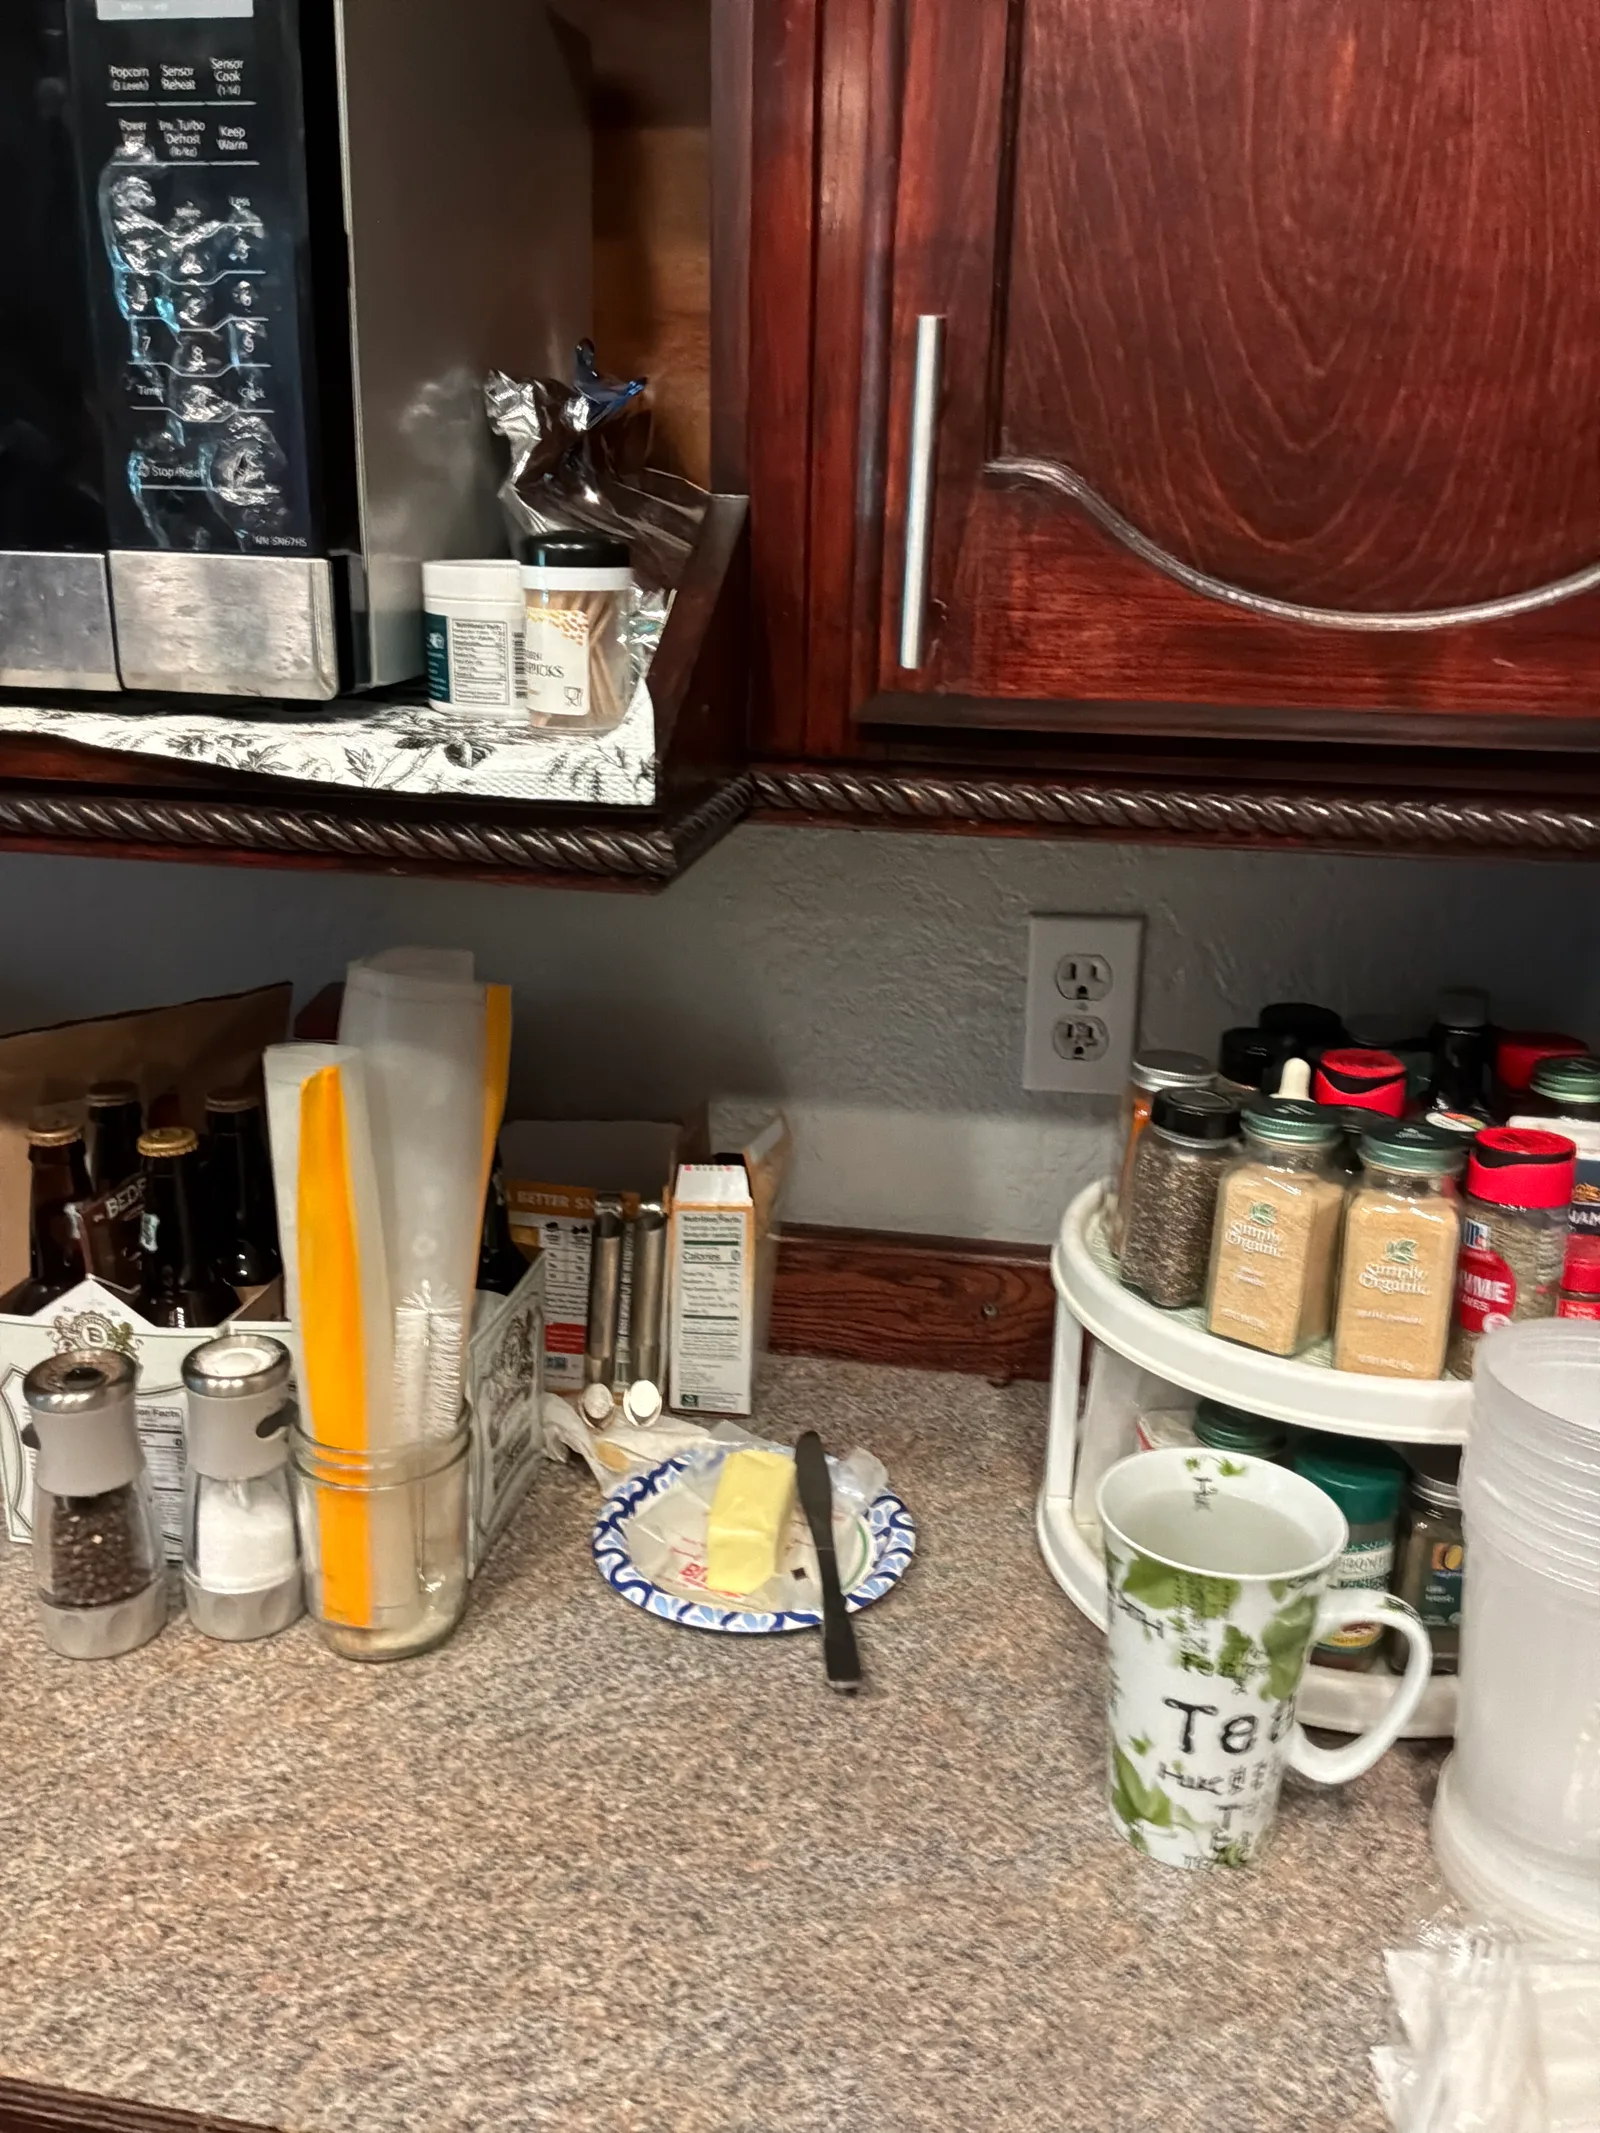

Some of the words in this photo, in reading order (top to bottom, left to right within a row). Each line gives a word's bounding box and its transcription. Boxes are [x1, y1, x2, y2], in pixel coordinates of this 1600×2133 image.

[209, 57, 244, 70] Sensor
[109, 65, 150, 79] Popcorn
[160, 64, 195, 77] Sensor
[215, 71, 241, 82] Cook
[161, 78, 196, 91] Reheat
[119, 119, 147, 131] Power
[177, 119, 206, 132] Turbo
[164, 132, 202, 145] Defrost
[219, 126, 246, 139] Keep
[217, 139, 248, 151] Warm
[527, 662, 565, 679] PICKS
[517, 1190, 570, 1208] BETTER
[1365, 1263, 1429, 1281] Simply
[1359, 1272, 1431, 1295] Organic
